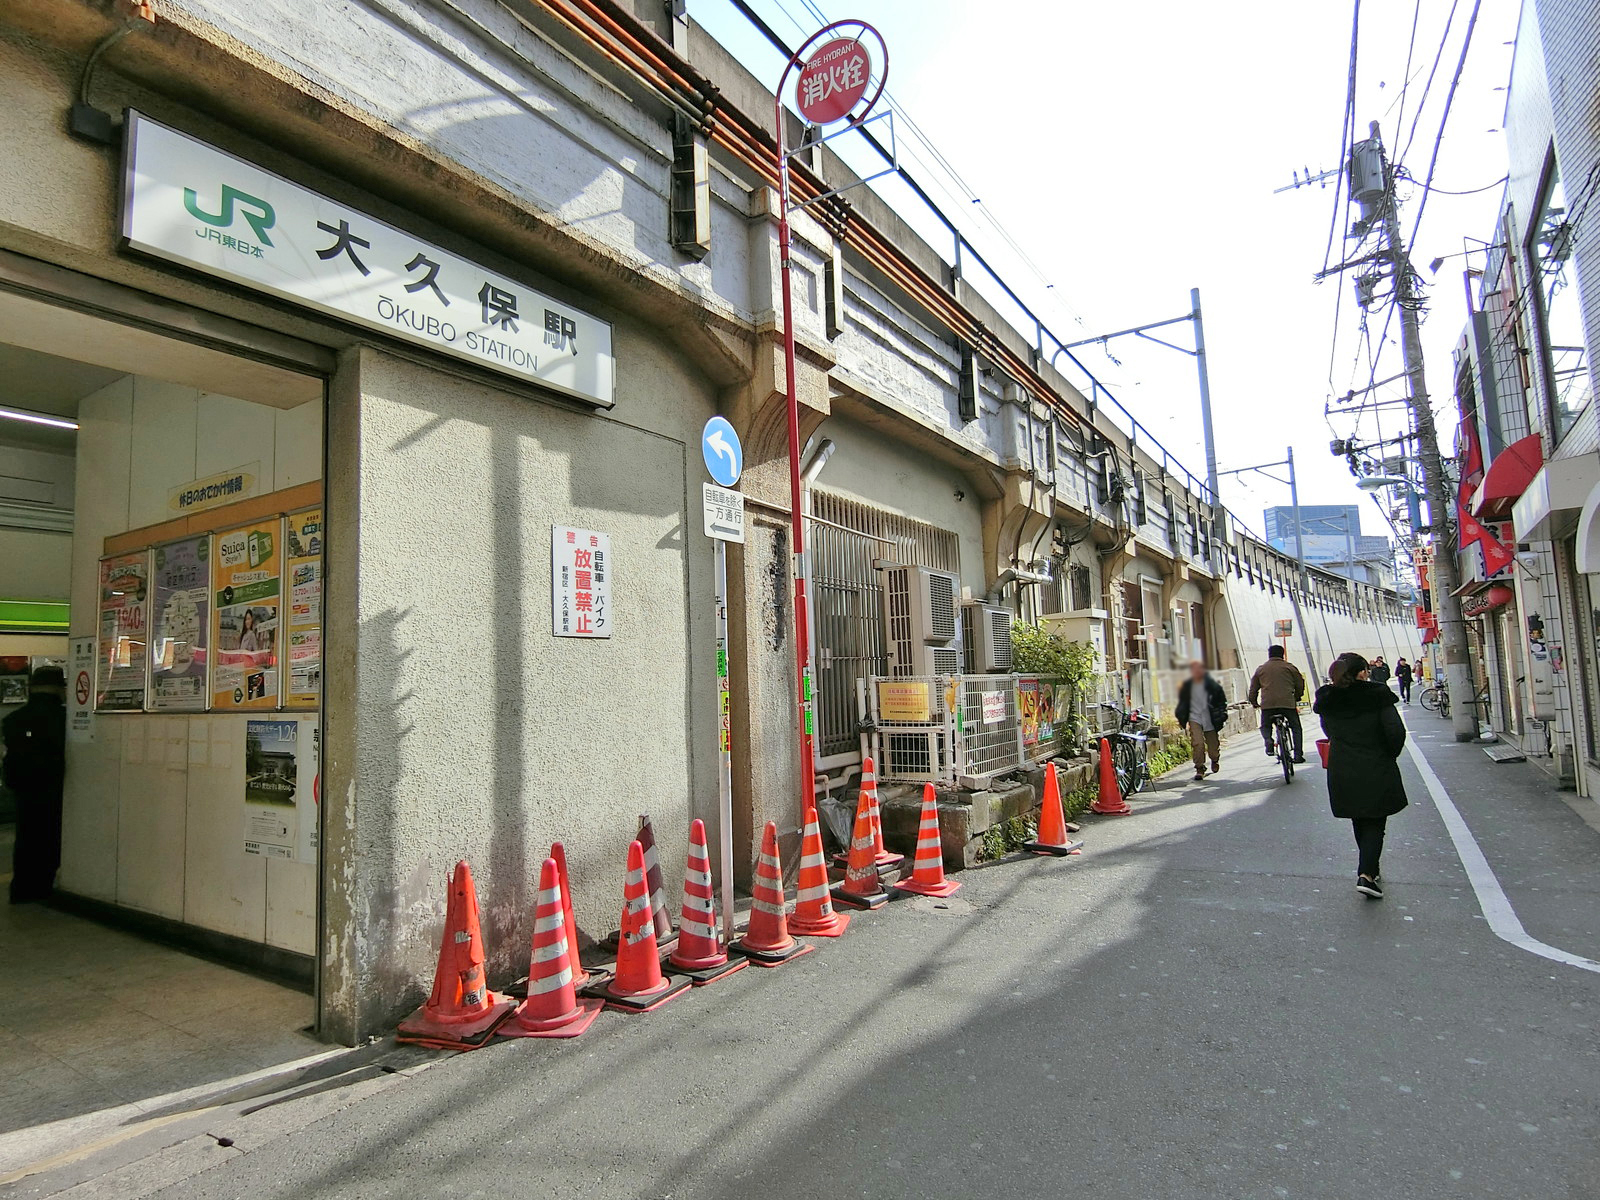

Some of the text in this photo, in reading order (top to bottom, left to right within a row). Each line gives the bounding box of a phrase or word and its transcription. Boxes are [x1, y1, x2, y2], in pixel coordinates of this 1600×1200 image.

[803, 55, 864, 108] 消火栓
[806, 42, 855, 72] FIRE HYDRANT
[183, 184, 276, 248] JR
[195, 227, 264, 259] JR東日本
[316, 219, 577, 357] 大久保駅
[377, 295, 539, 372] ŌKUBO STATION
[179, 475, 243, 508] 休日のおでかけ情報
[706, 507, 742, 524] 一方通行
[221, 541, 245, 557] Suica
[574, 548, 593, 634] 放置禁止
[594, 550, 605, 628] 自転車・バイク
